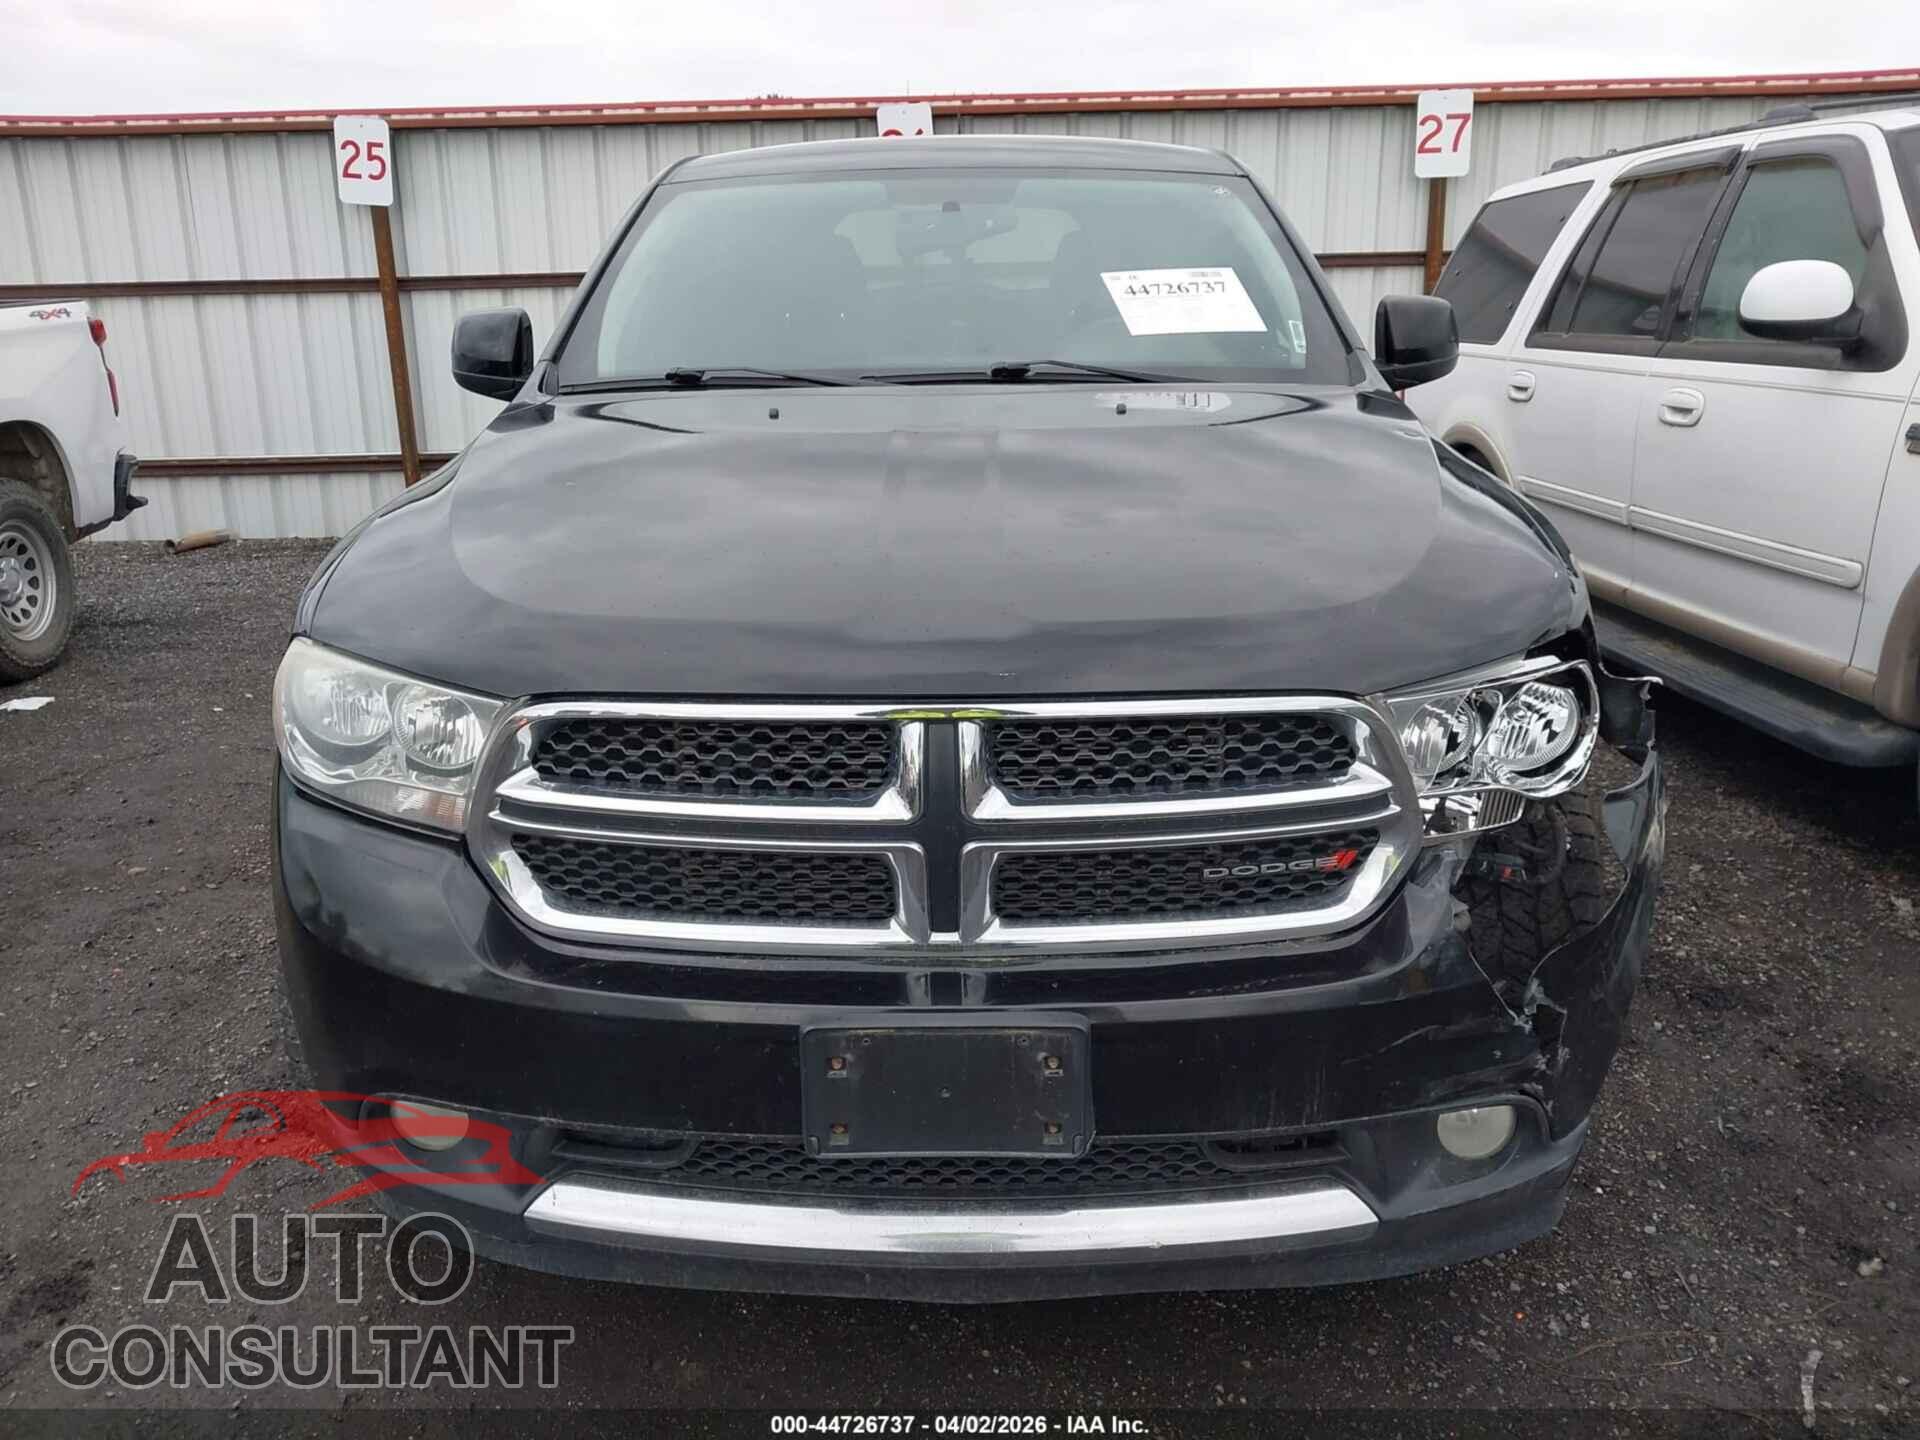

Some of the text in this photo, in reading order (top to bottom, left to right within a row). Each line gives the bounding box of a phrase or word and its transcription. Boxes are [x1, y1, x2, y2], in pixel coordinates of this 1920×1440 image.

[1417, 113, 1472, 154] 27
[340, 139, 386, 181] 25
[1124, 280, 1226, 297] 44726737
[1202, 854, 1338, 880] DODGE
